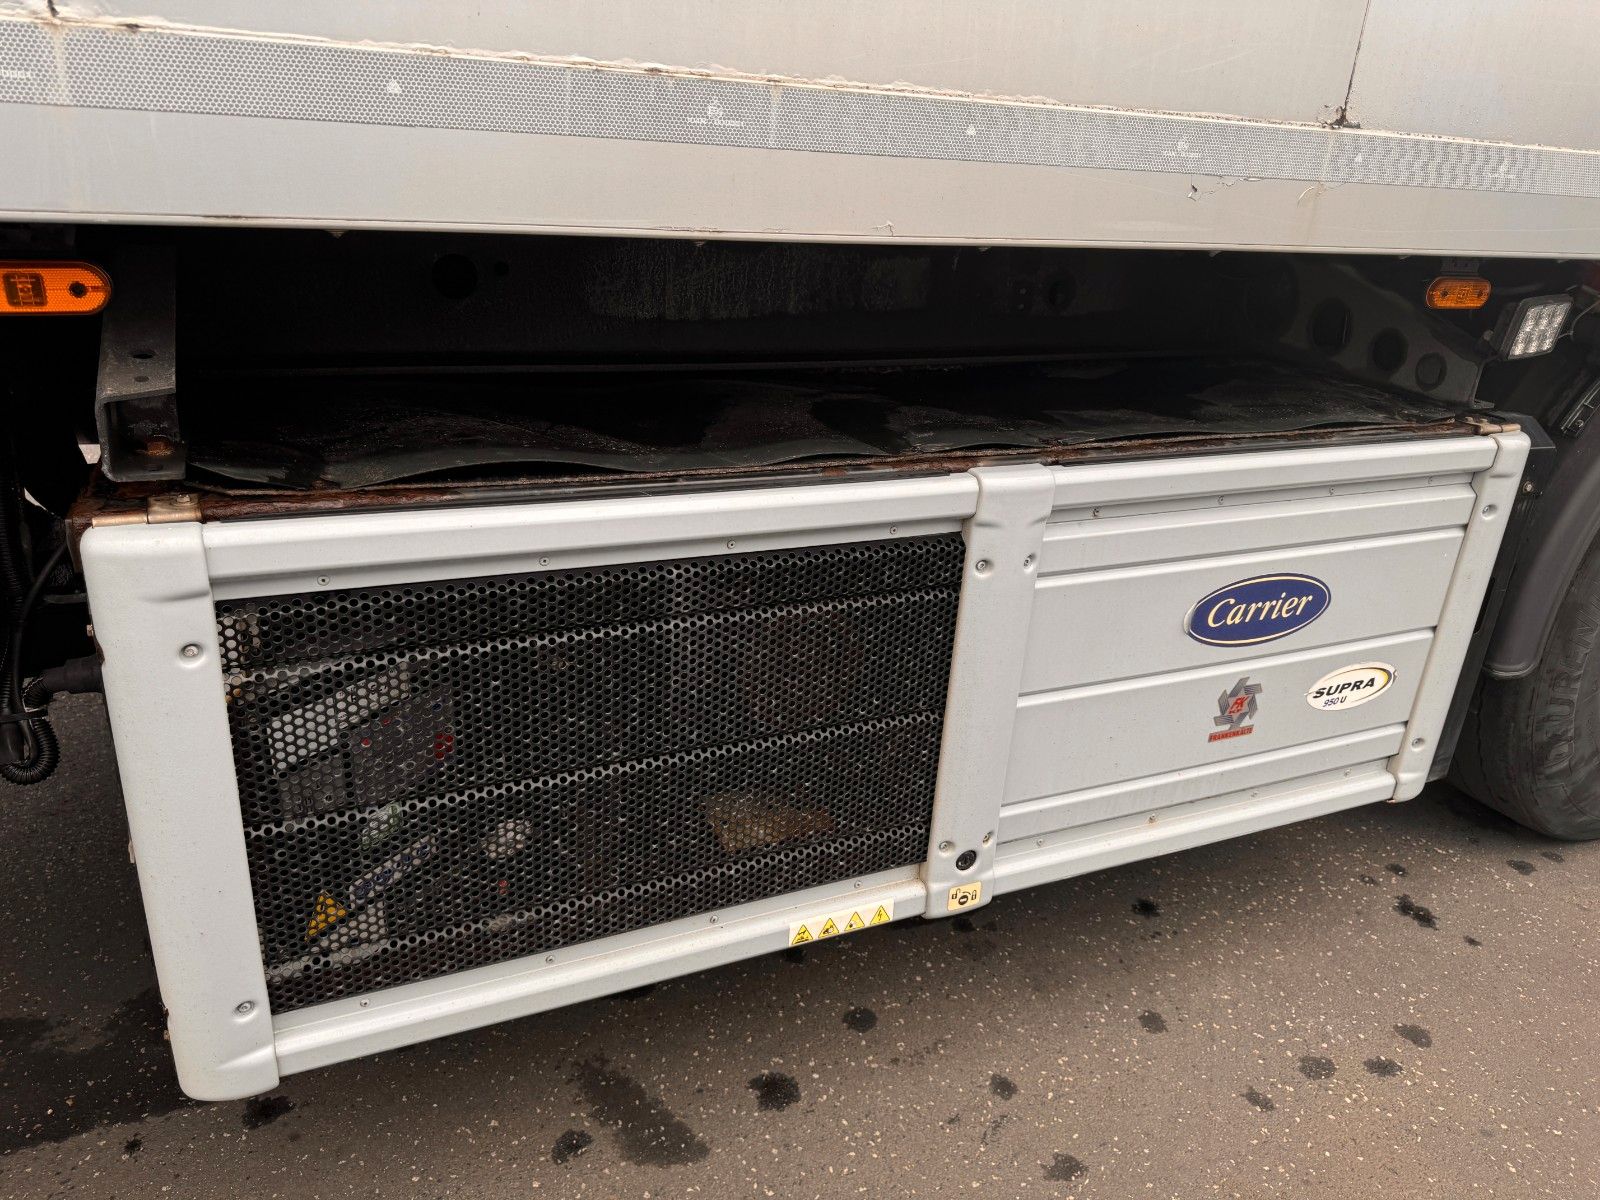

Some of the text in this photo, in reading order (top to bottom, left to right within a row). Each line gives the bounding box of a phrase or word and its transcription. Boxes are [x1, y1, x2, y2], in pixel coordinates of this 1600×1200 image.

[1207, 592, 1313, 628] Carrier
[1312, 677, 1376, 699] SUPRA
[1322, 695, 1348, 707] 950 U
